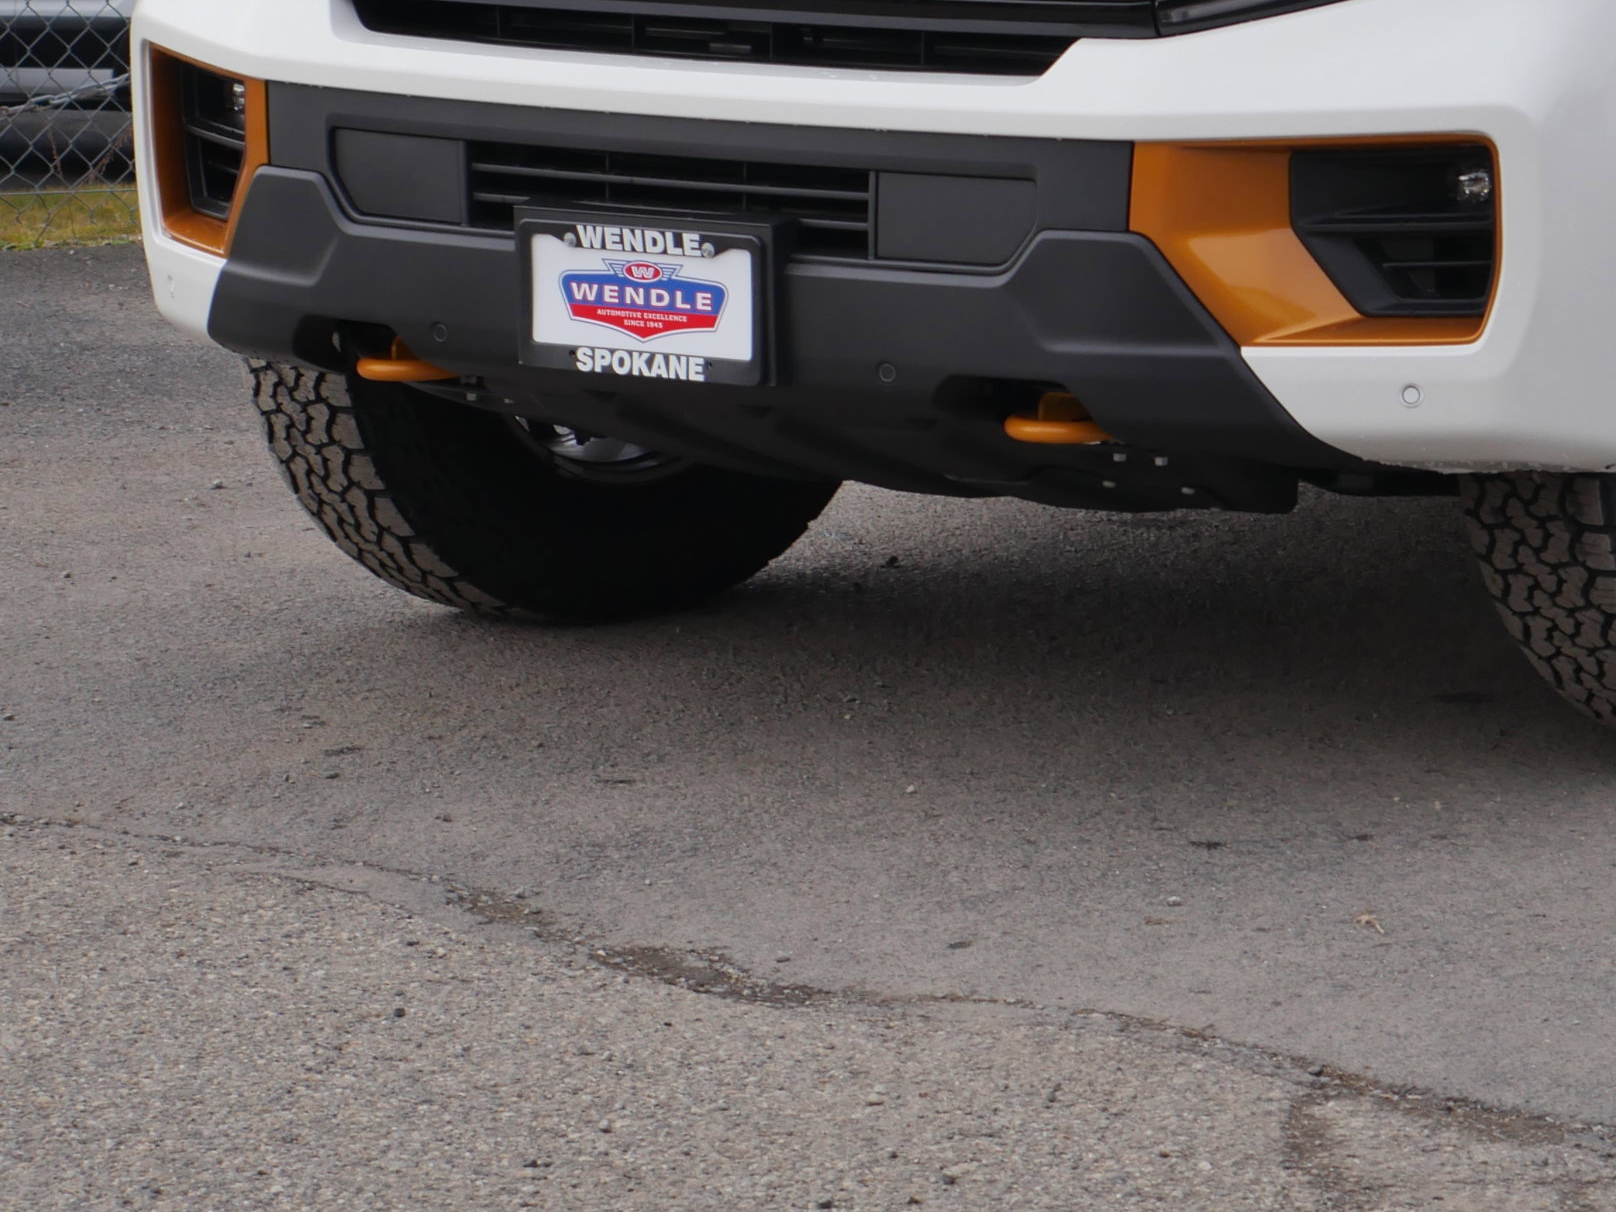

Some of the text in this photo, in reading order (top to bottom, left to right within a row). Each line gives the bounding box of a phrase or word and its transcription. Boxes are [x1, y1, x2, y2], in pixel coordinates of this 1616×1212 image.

[576, 224, 702, 257] WENDLE
[570, 282, 712, 311] WENDLE
[597, 308, 688, 323] AUTOMOTIVE EXCELLENCE
[623, 319, 664, 329] SINCE 1943
[575, 346, 706, 382] SPOKANE
